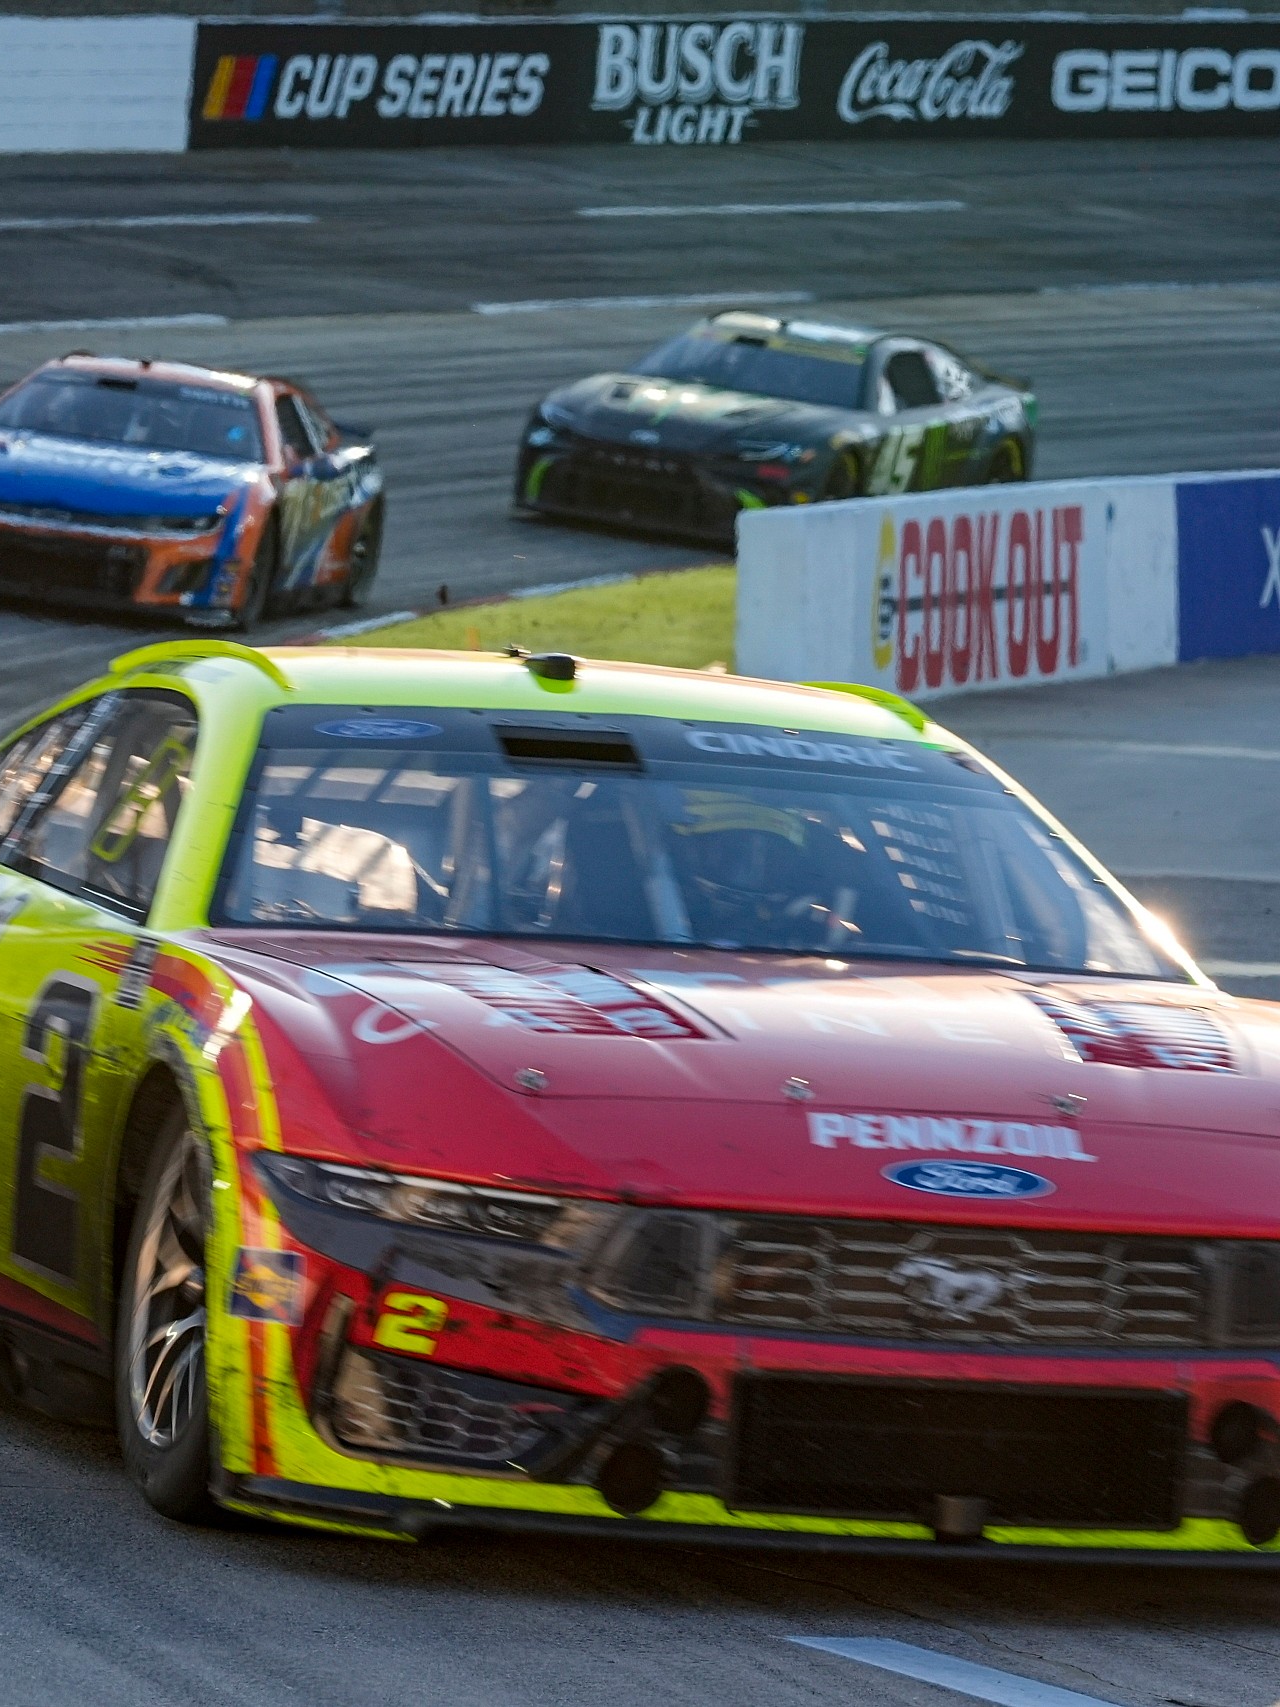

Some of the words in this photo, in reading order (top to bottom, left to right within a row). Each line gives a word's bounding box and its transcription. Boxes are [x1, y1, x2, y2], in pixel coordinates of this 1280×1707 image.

[273, 53, 379, 119] CUP
[378, 52, 550, 119] SERIES
[591, 22, 806, 109] BUSCH
[1052, 48, 1280, 112] GEICO
[630, 105, 750, 145] LIGHT
[896, 512, 1000, 693] COOK
[1007, 506, 1083, 678] OUT
[686, 730, 919, 772] CINDRIC
[806, 1112, 1098, 1163] PENNZOIL
[373, 1292, 448, 1356] 2
